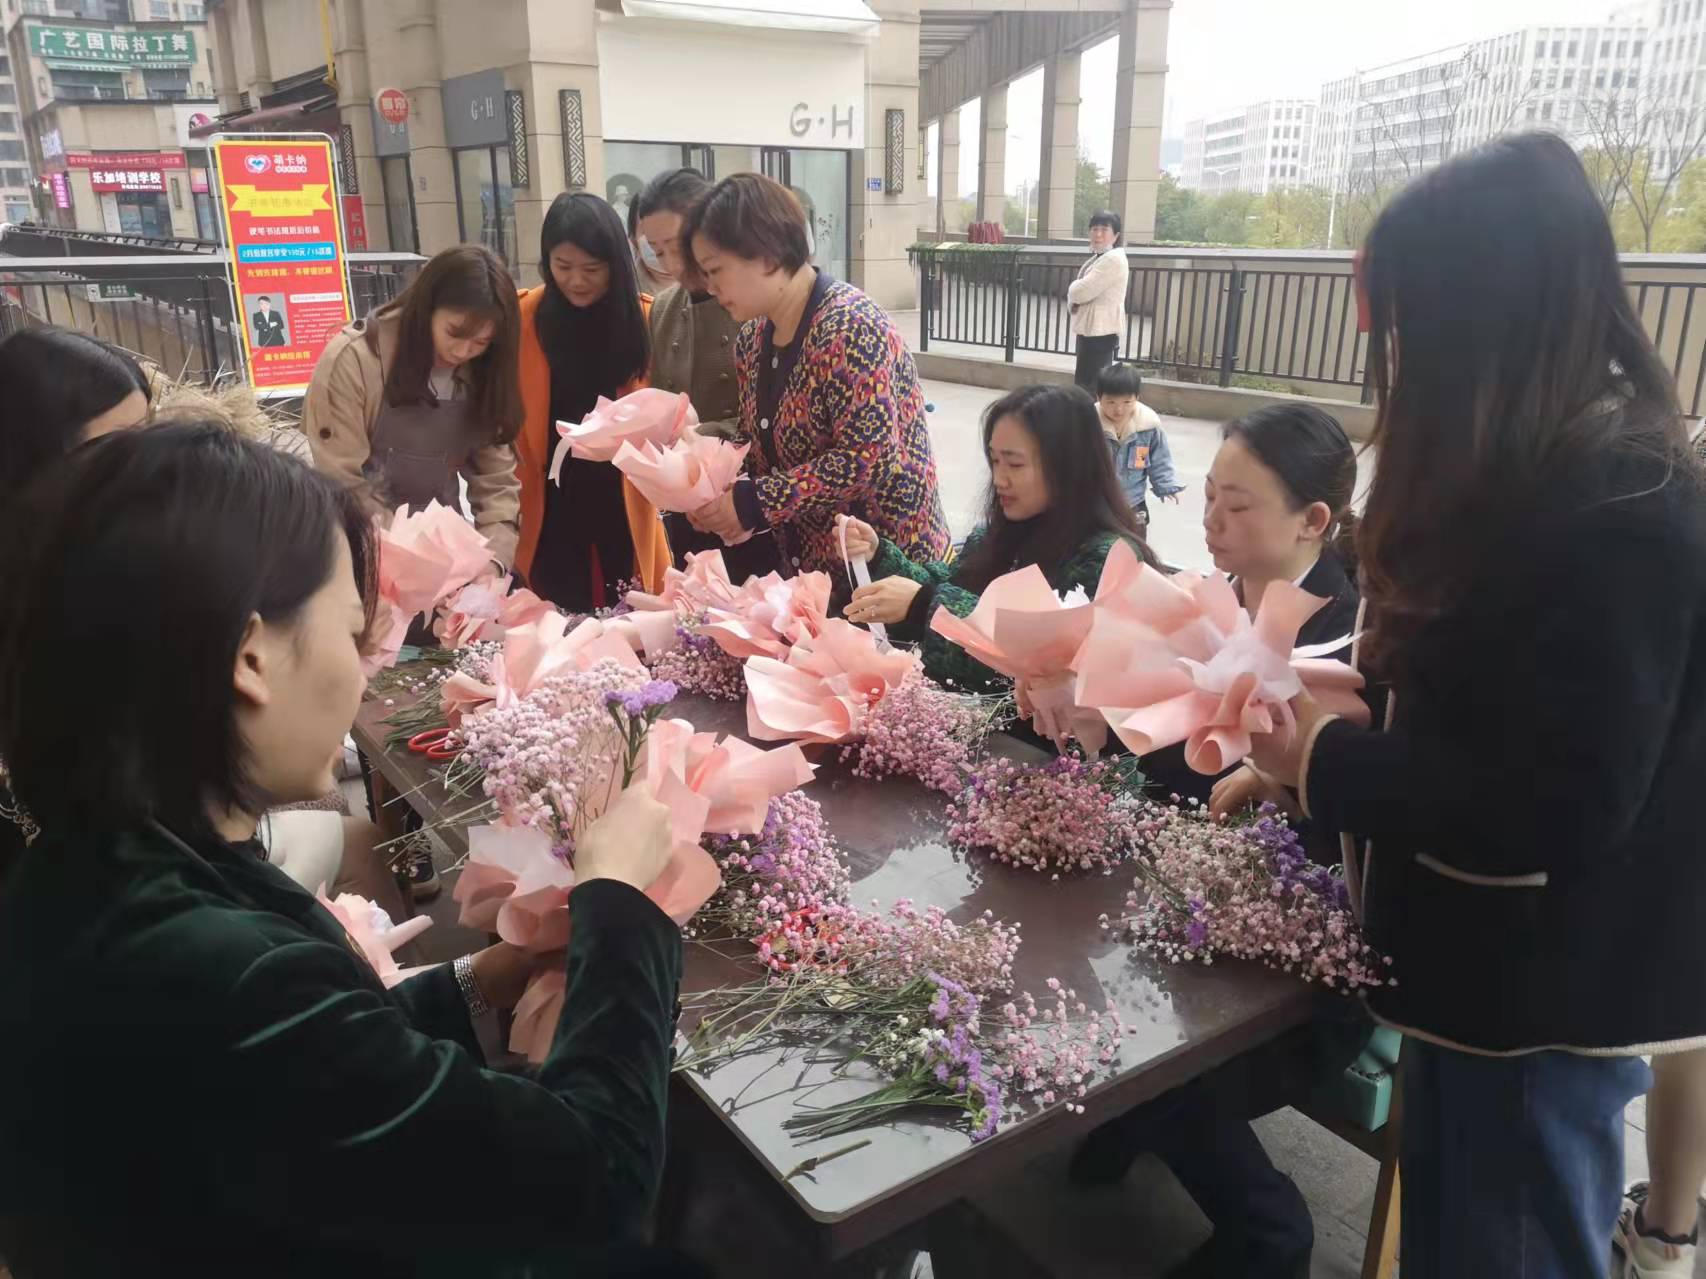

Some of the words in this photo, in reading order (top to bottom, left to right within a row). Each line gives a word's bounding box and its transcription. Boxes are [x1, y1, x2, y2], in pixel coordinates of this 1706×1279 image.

[39, 30, 188, 52] 广艺国际拉丁舞
[92, 171, 161, 184] 乐加培训学校
